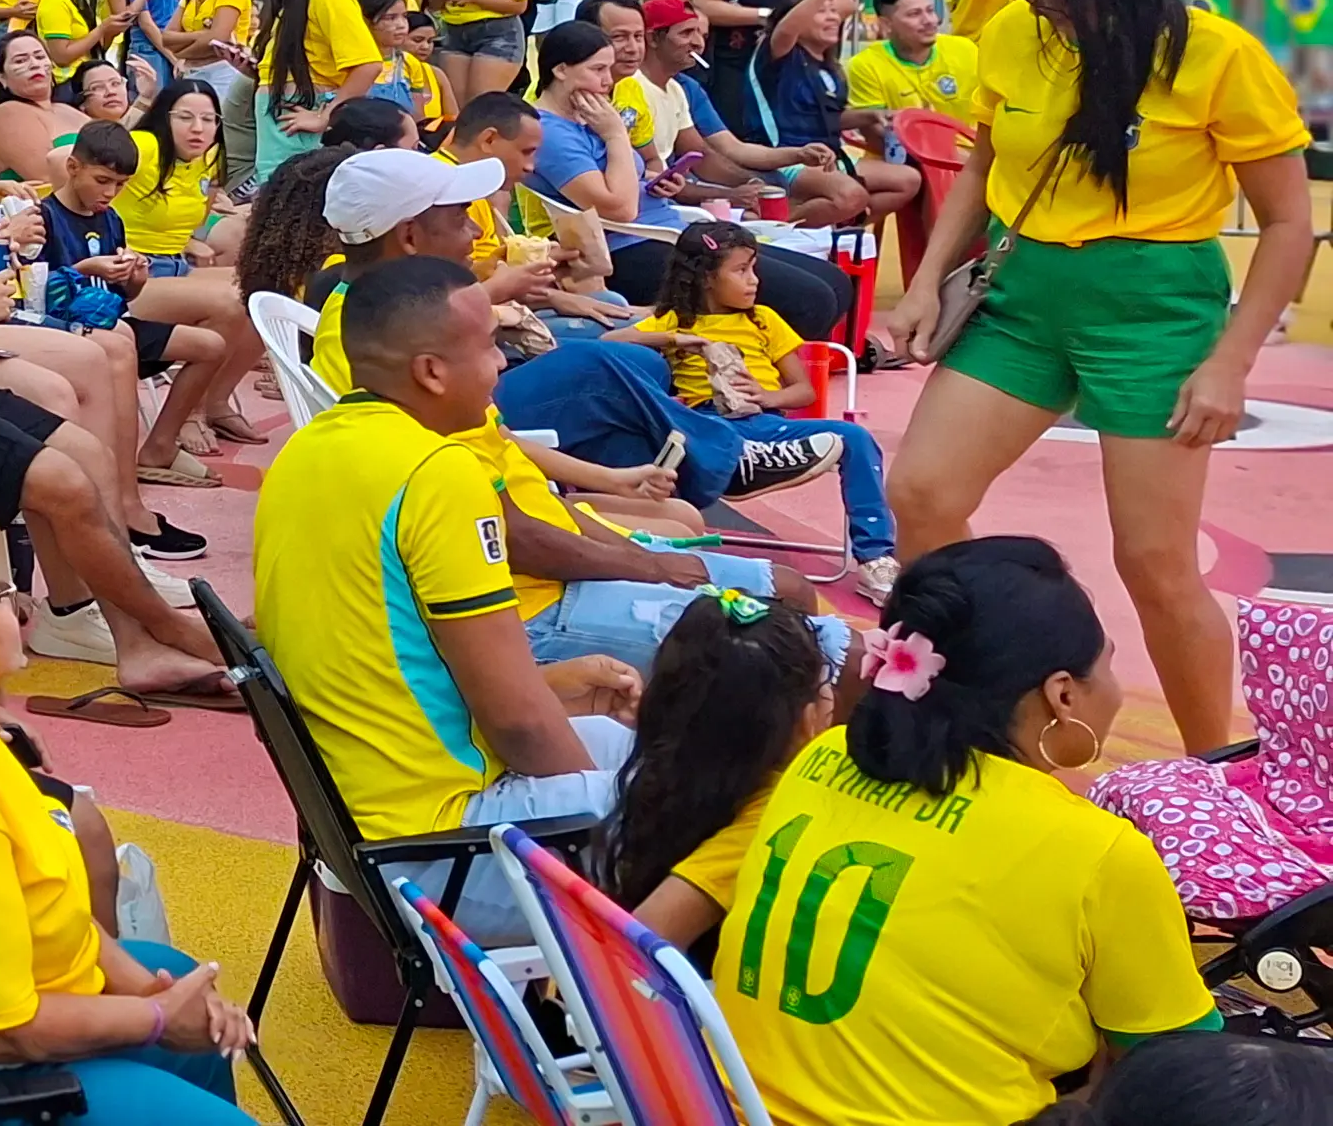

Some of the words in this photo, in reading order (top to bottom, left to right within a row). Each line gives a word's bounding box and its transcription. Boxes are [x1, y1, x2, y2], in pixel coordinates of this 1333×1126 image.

[797, 745, 914, 814] NEYMAR
[914, 794, 974, 835] JR
[737, 813, 916, 1025] 10
